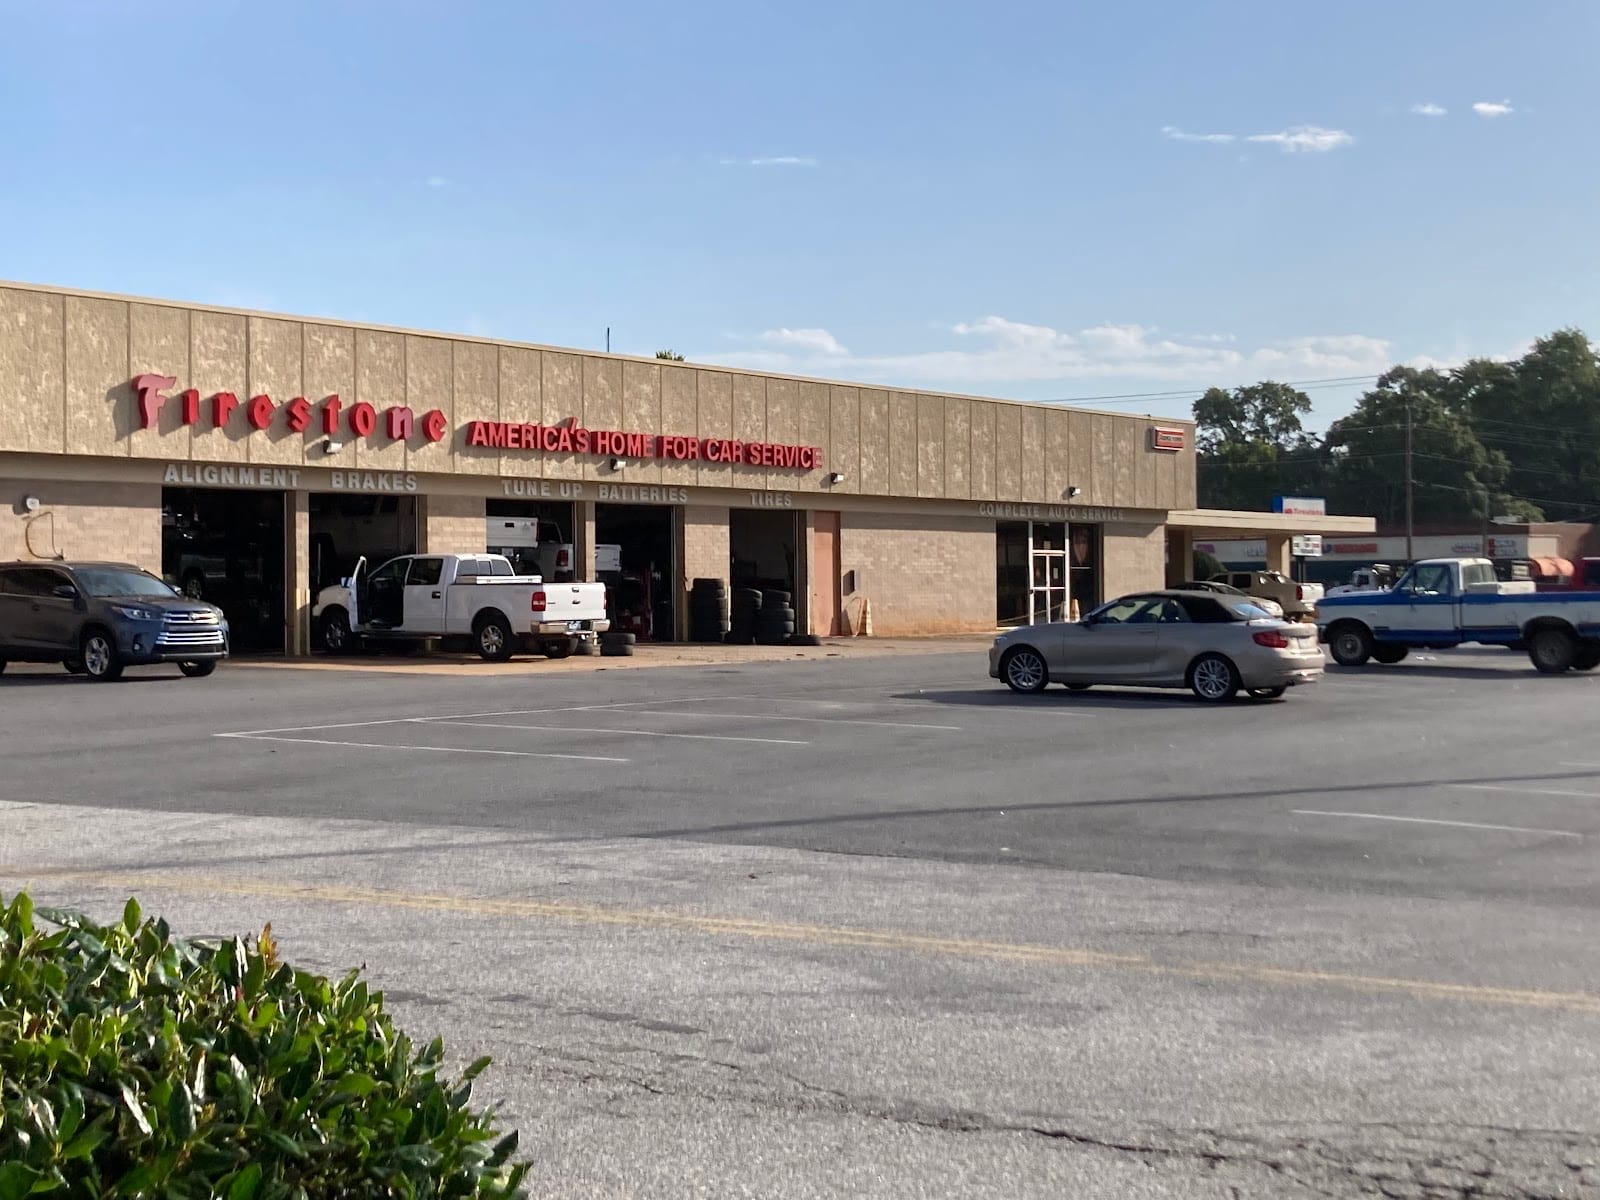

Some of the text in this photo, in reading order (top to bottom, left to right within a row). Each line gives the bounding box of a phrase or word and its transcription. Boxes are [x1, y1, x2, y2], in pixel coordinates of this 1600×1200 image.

[132, 373, 447, 442] Firestone
[468, 417, 823, 469] AMERICA'S HOME FOR CAR SERVICE
[164, 464, 300, 487] ALIGNMENT
[331, 471, 417, 492] BRAKES
[502, 480, 583, 498] TUNE UP
[599, 484, 688, 503] BATTERIES
[750, 491, 792, 507] TIRES
[979, 503, 1124, 521] COMPLETE AUTO SERVICE
